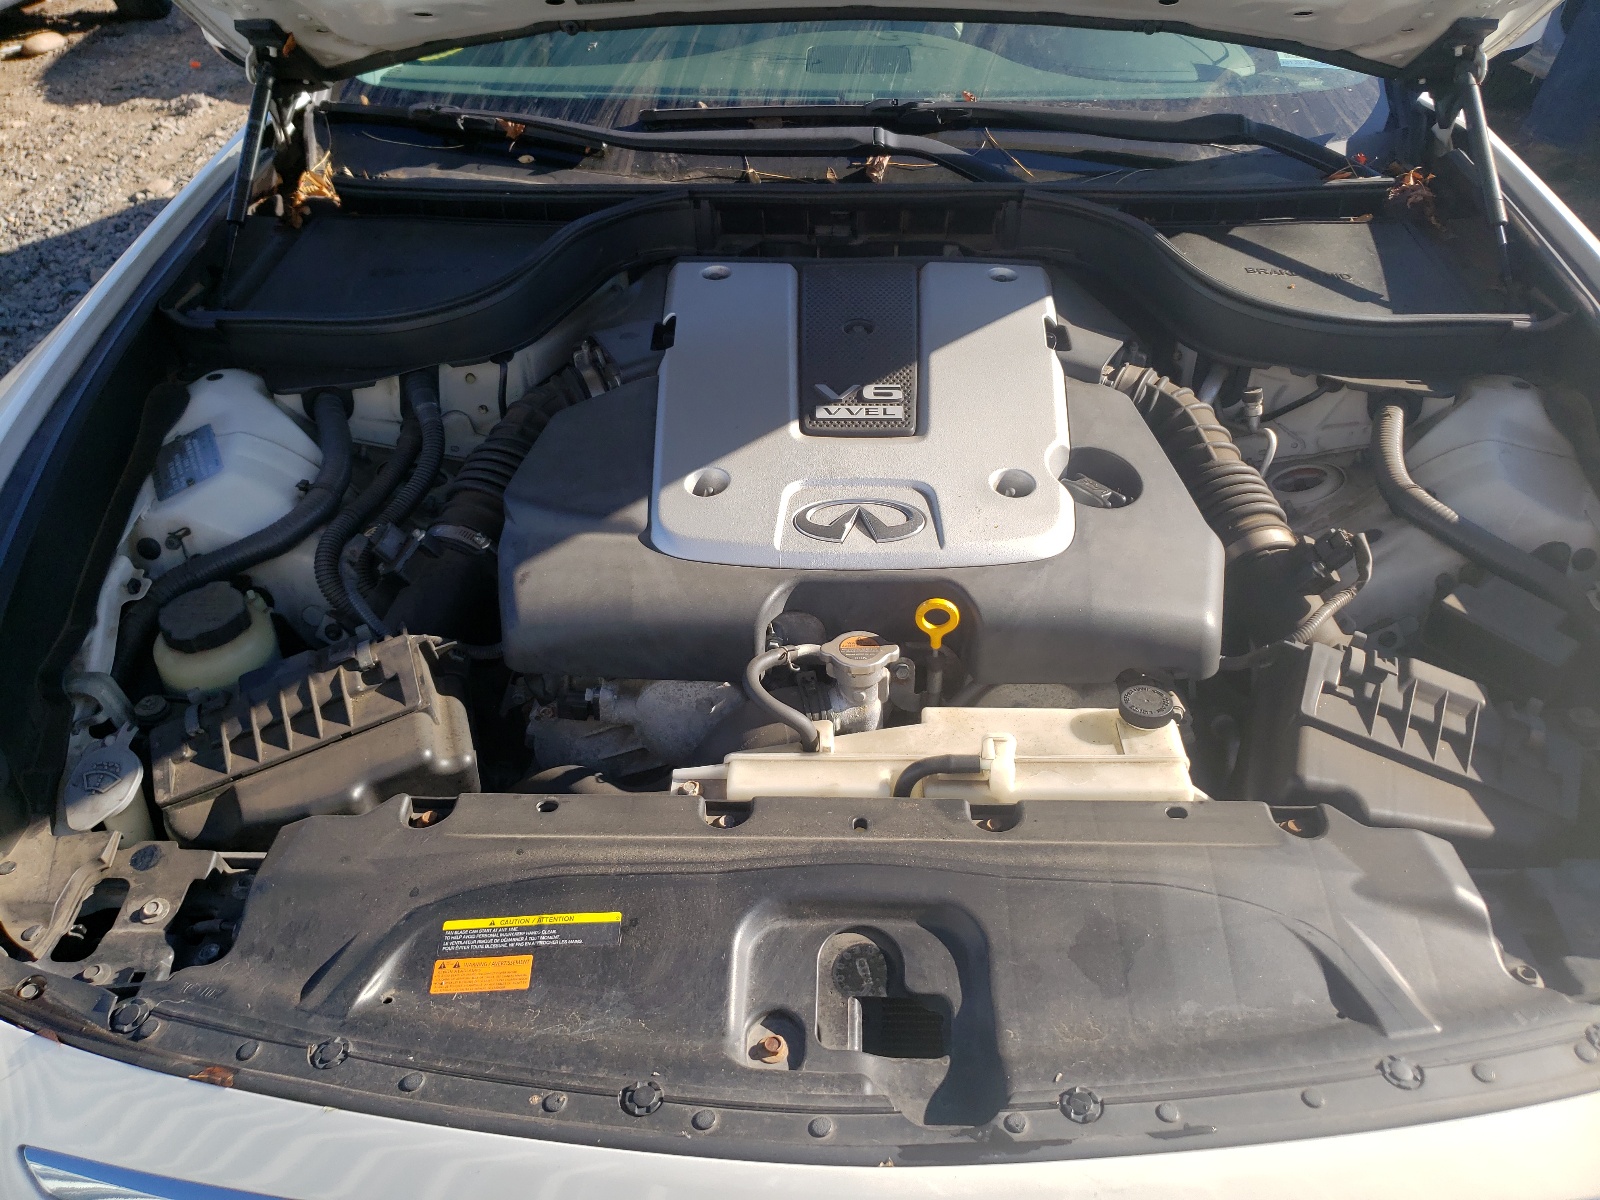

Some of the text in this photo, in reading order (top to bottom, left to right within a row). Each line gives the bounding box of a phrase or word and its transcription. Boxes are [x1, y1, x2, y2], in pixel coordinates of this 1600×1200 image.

[814, 384, 904, 400] V6
[823, 407, 896, 416] VVEL
[500, 918, 530, 926] CAUTION
[537, 916, 575, 924] ATTENTION
